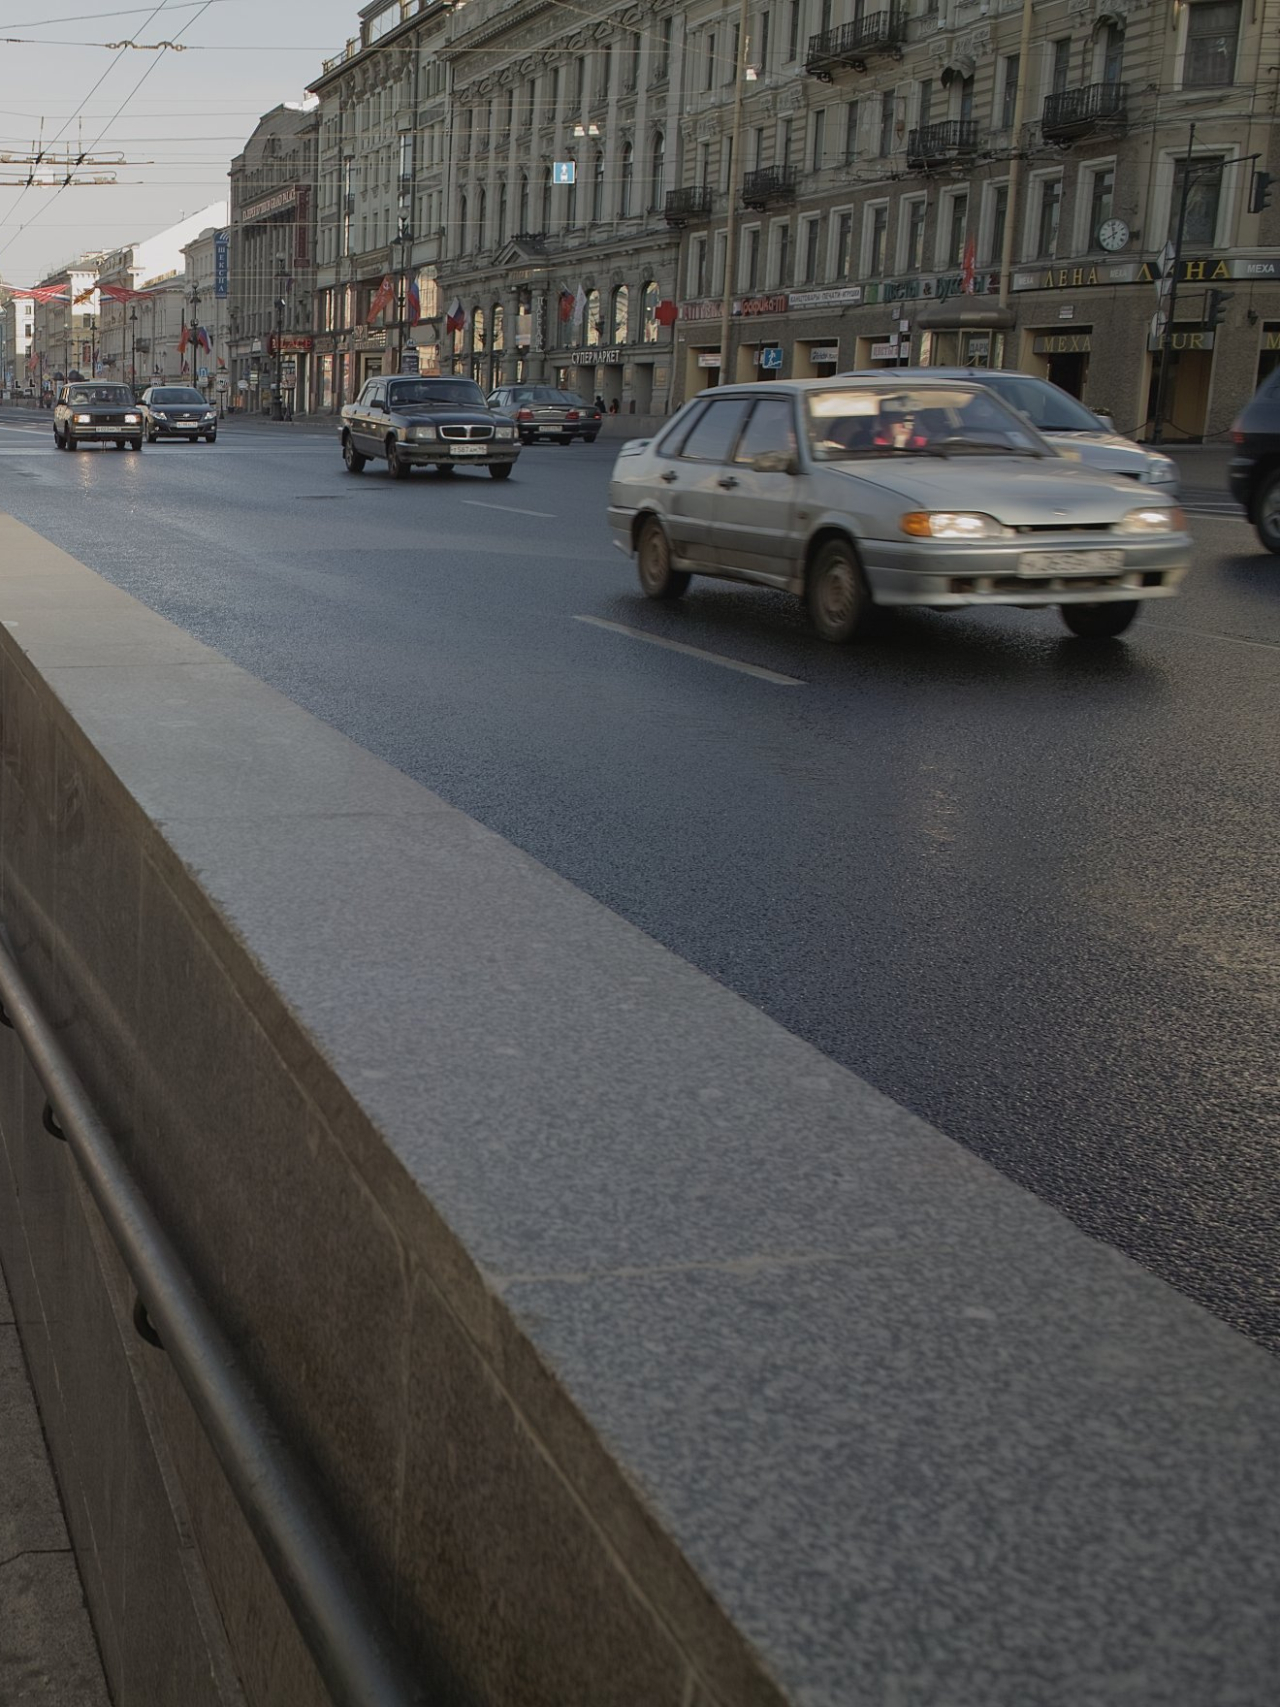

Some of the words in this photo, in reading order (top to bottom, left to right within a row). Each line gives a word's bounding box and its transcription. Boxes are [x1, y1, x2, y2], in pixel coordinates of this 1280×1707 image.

[218, 246, 226, 292] ШЕКСНА
[1109, 269, 1127, 279] МЕХА
[1247, 263, 1275, 273] МЕХА
[1044, 266, 1098, 288] ЛЕНА
[271, 338, 313, 349] PLACE
[1042, 335, 1092, 352] МЕХА
[571, 350, 620, 364] СУПЕРМАРКЕТ
